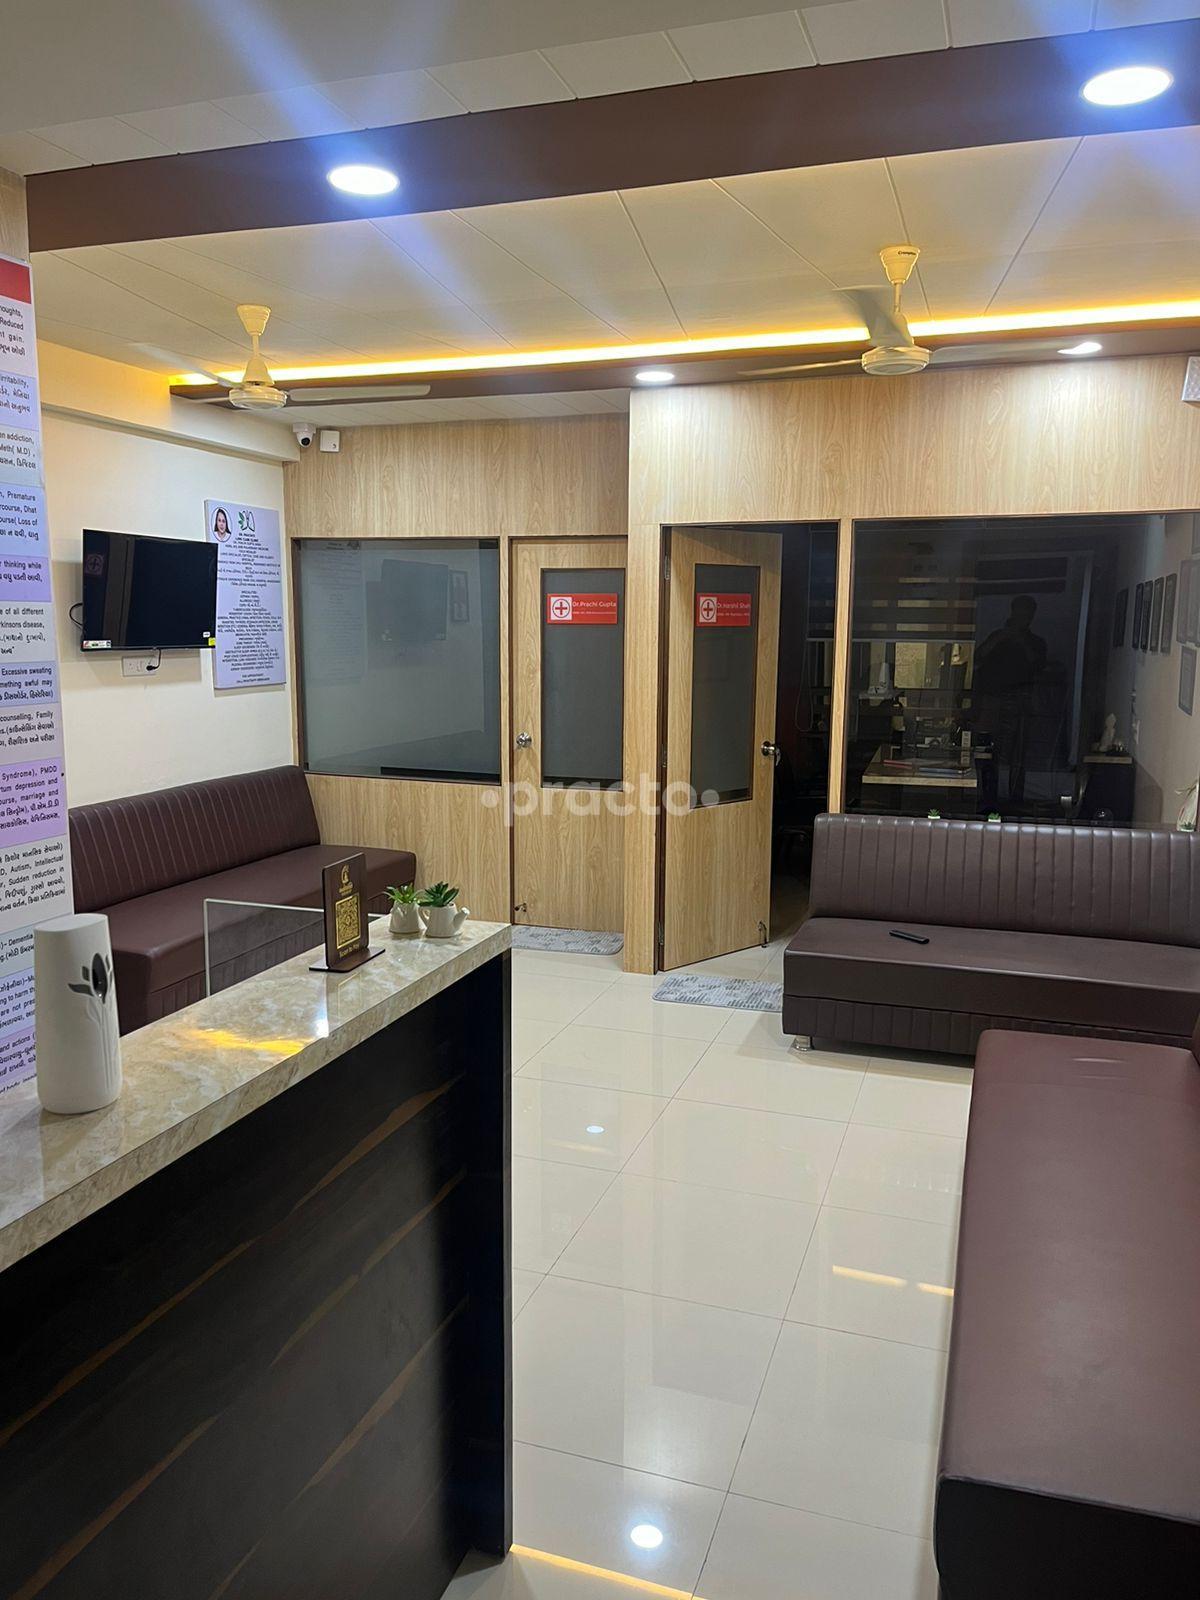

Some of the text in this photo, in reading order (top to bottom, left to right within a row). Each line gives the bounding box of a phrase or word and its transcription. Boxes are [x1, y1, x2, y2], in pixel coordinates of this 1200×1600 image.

[7, 490, 36, 501] Premature
[18, 517, 31, 526] Loss
[4, 560, 26, 571] thinking
[1, 666, 52, 676] Excessive sweating
[25, 679, 39, 687] awful
[42, 679, 53, 687] may
[36, 710, 53, 720] Family
[15, 780, 46, 791] depression
[48, 777, 58, 785] and
[20, 792, 46, 802] marriage
[48, 789, 59, 797] and
[11, 863, 32, 873] Autism,
[34, 854, 64, 867] Intellectual
[9, 875, 29, 886] Sudden
[32, 868, 57, 879] reduction
[14, 989, 29, 1000] harm
[0, 1008, 9, 1017] are
[12, 1003, 21, 1012] not
[12, 1035, 31, 1048] actions
